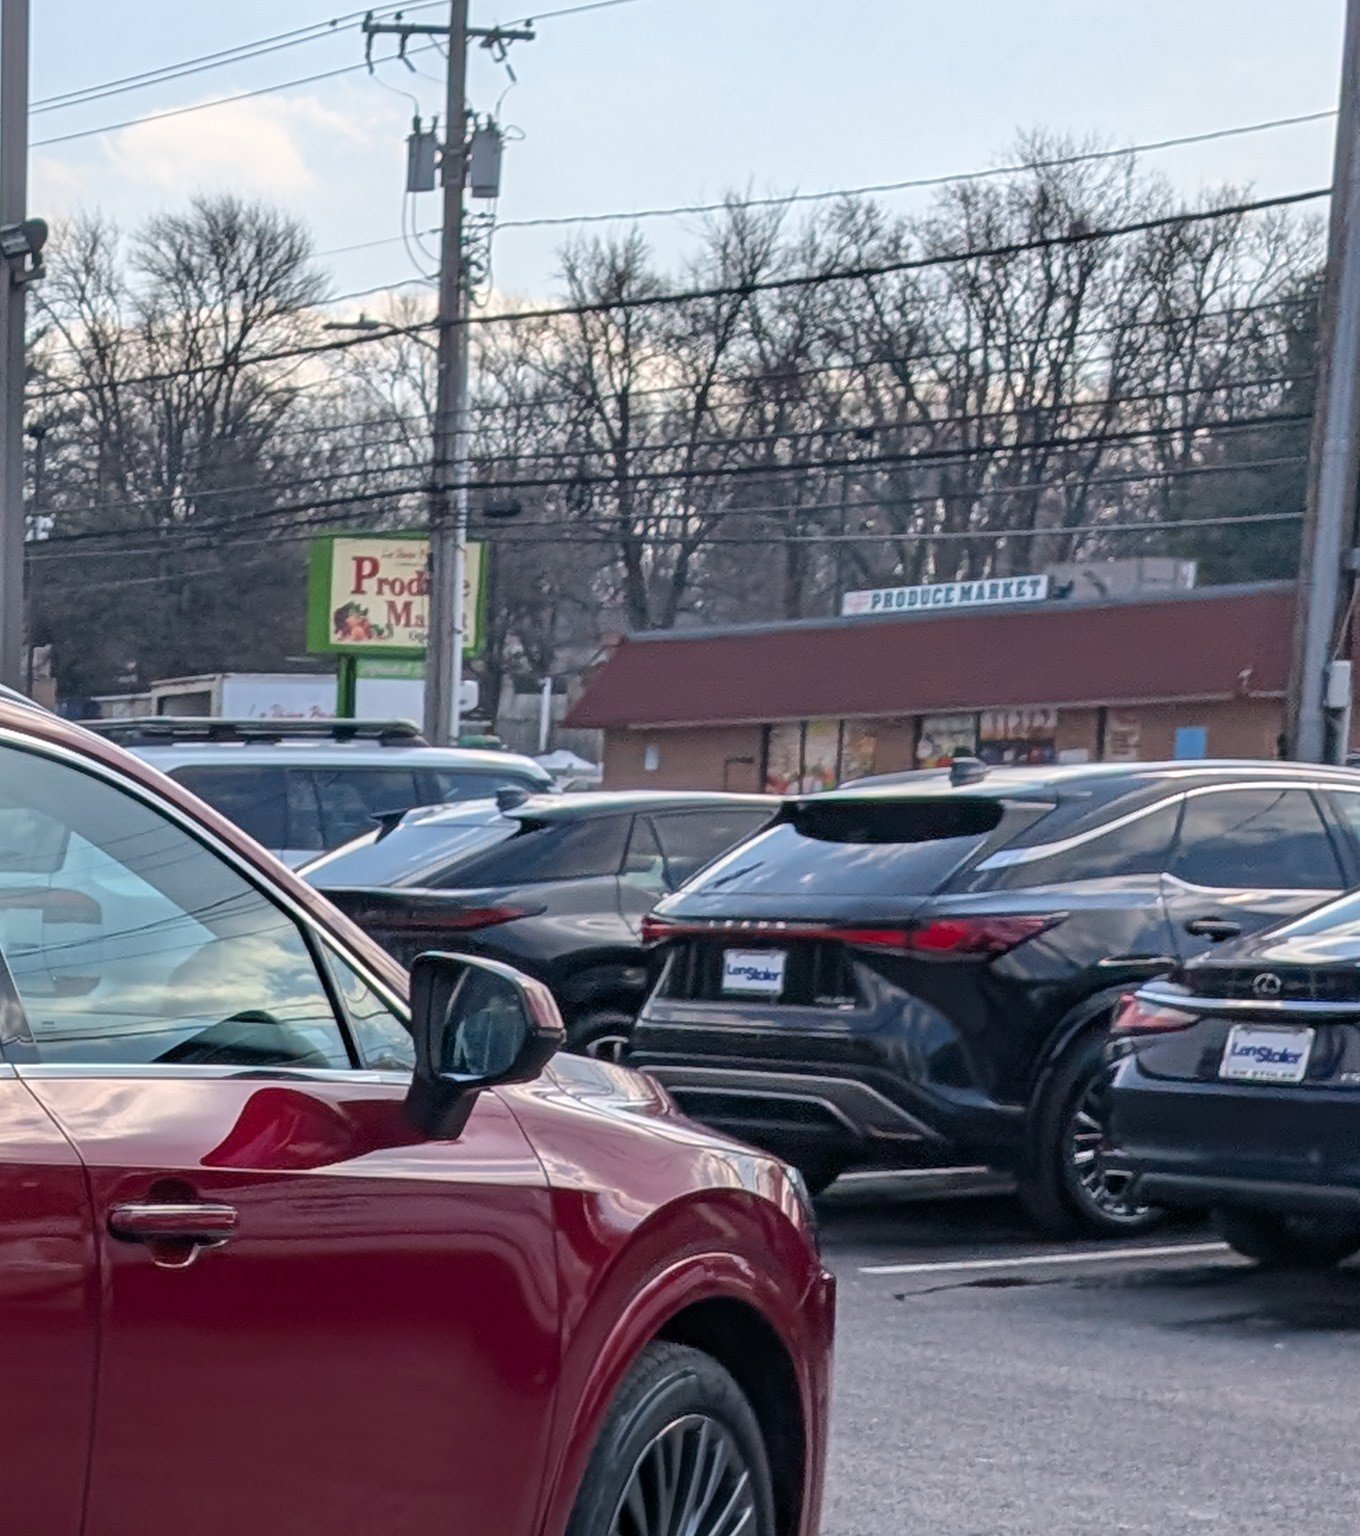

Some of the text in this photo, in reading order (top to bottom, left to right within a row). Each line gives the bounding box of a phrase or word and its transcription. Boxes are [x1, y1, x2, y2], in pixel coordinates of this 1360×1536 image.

[350, 555, 470, 598] Prod
[871, 579, 1041, 609] PRODUCE MARKET
